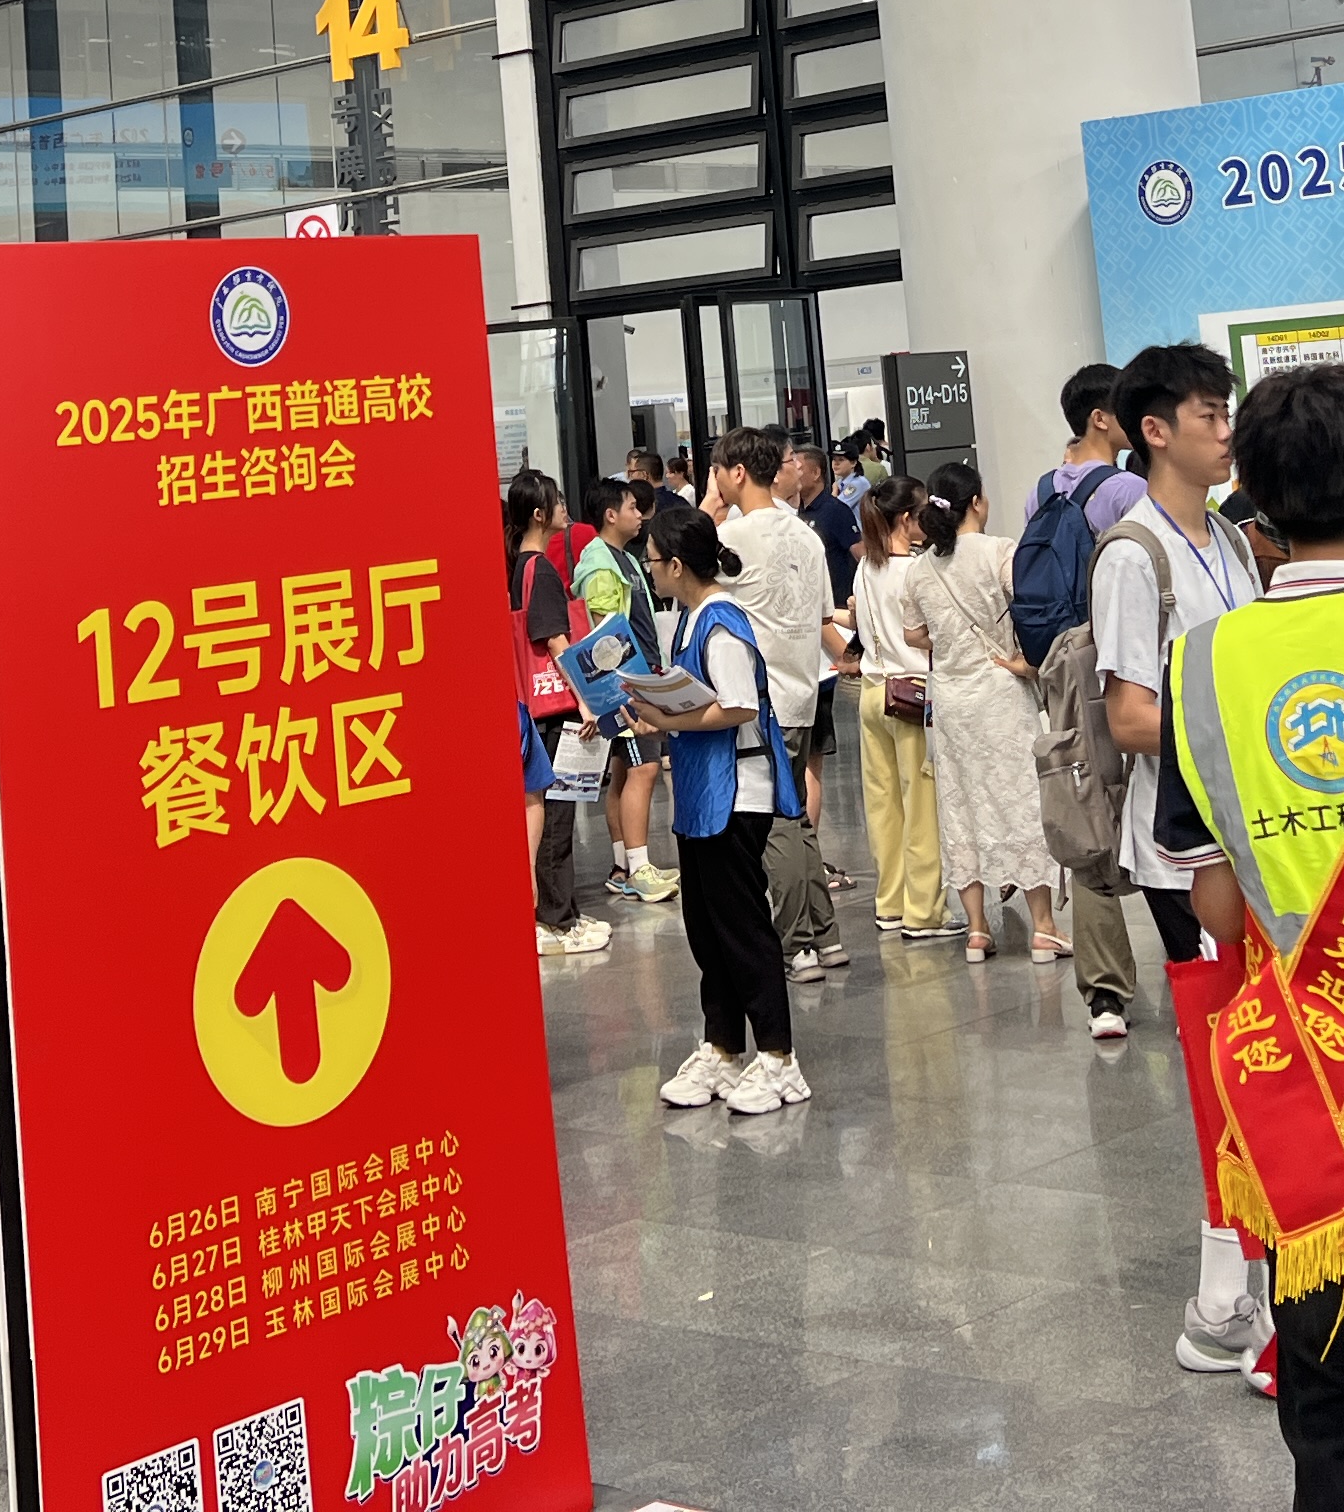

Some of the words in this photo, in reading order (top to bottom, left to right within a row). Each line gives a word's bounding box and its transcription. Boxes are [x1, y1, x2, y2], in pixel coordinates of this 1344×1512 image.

[54, 372, 434, 448] 2025年广西普通高校
[157, 439, 357, 506] 招生咨询会
[76, 558, 441, 710] 12号展厅
[139, 692, 411, 849] 餐饮区
[149, 1195, 240, 1248] 6月26日
[254, 1129, 460, 1219] 南宁国际会展中心
[152, 1236, 242, 1290] 6月27日
[258, 1167, 463, 1259] 桂林甲天下会展中心
[155, 1275, 248, 1331] 6月28日
[261, 1205, 467, 1299] 柳州国际会展中心
[158, 1316, 250, 1374] 6月29日
[264, 1243, 470, 1338] 玉林国际会展中心
